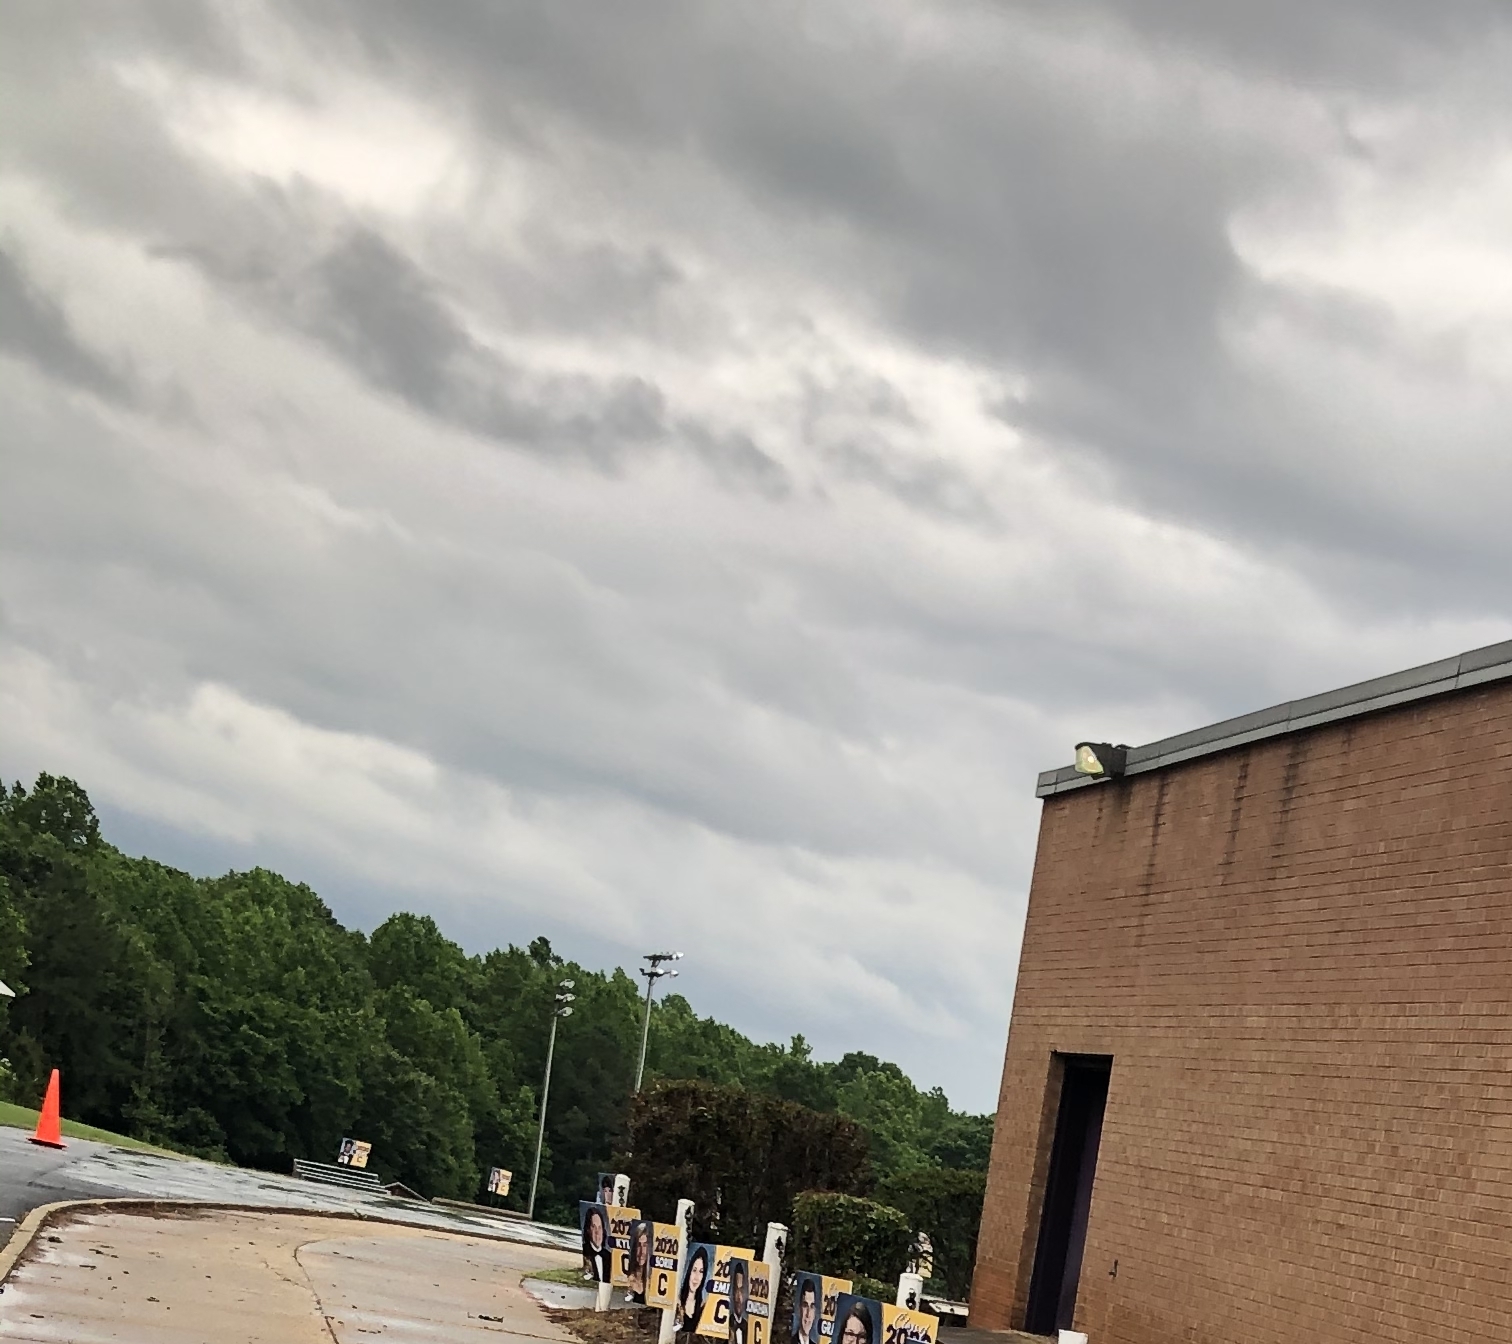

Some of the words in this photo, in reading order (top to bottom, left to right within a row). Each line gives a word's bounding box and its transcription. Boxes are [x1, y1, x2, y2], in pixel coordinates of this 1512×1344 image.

[611, 1218, 632, 1236] 202
[654, 1236, 679, 1255] 2020
[715, 1259, 731, 1278] 20
[657, 1271, 669, 1297] C
[712, 1297, 730, 1326] C
[823, 1294, 836, 1317] 20
